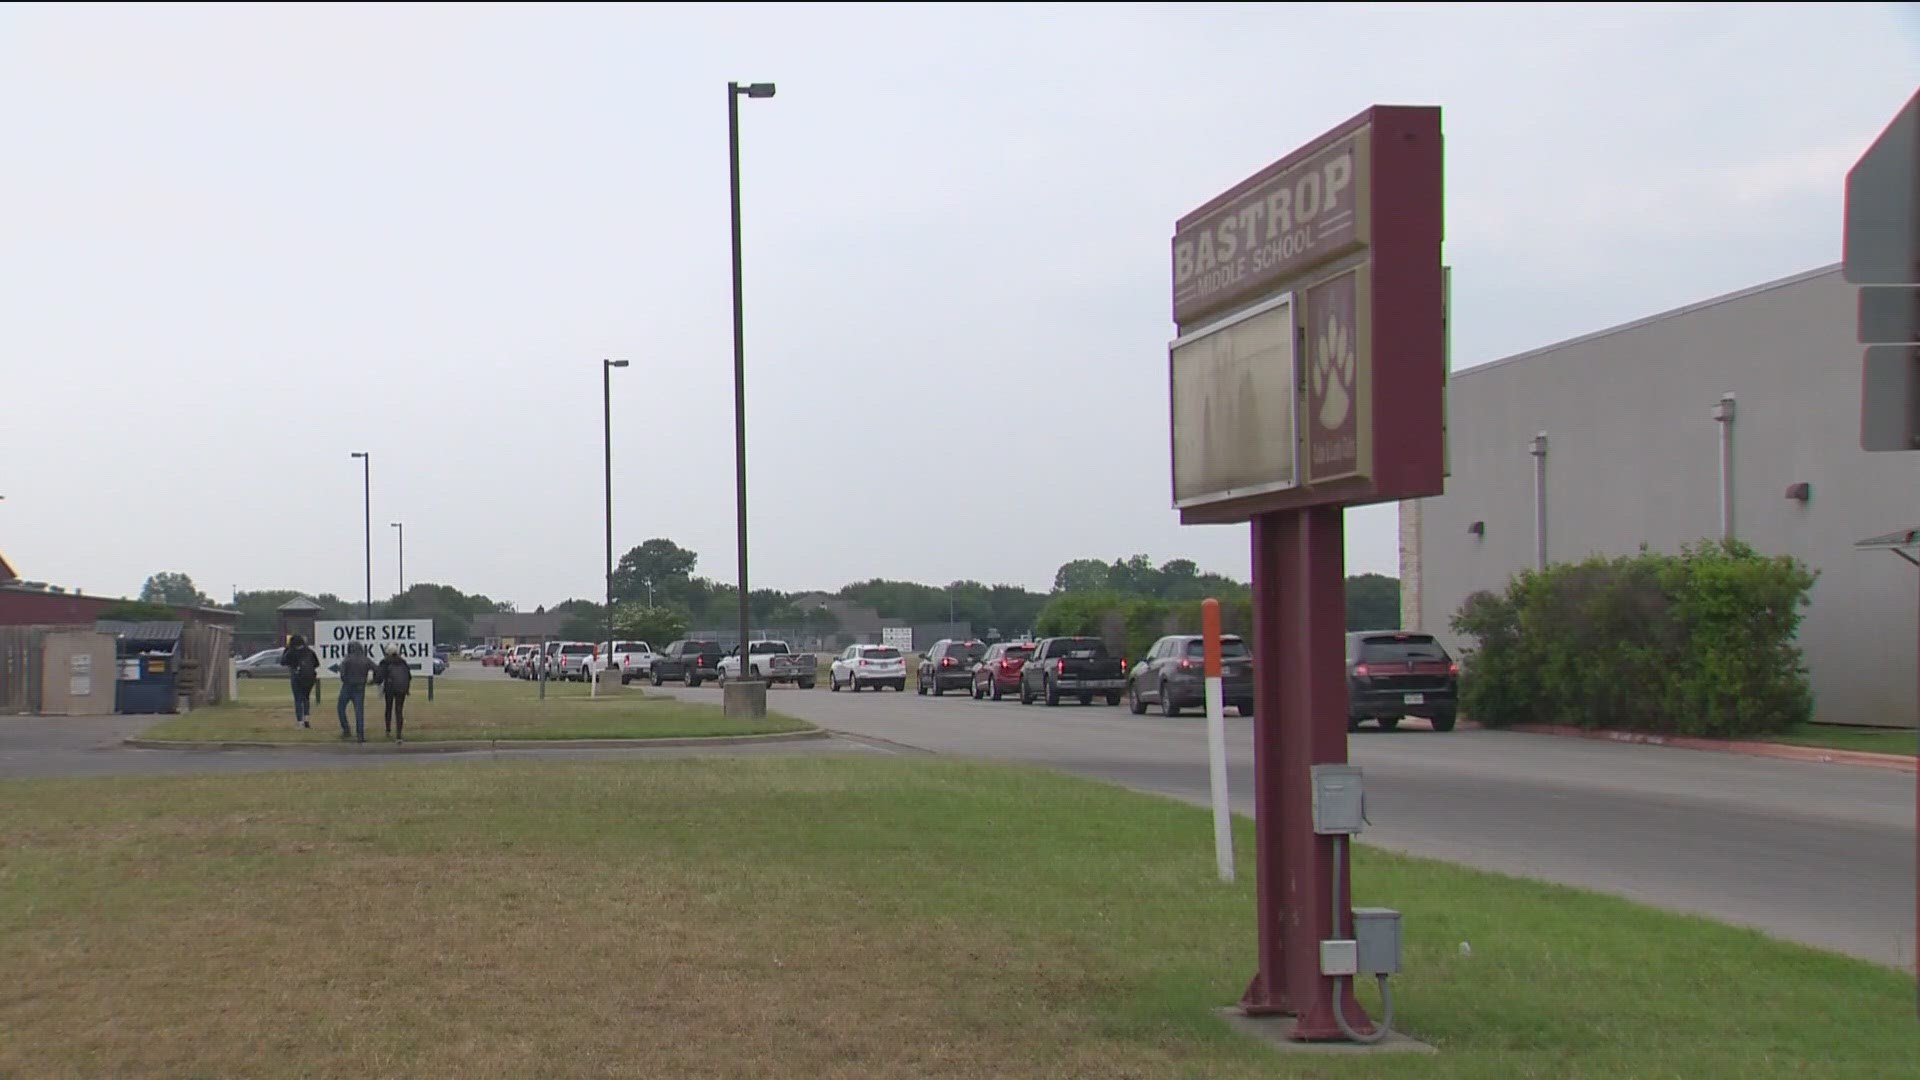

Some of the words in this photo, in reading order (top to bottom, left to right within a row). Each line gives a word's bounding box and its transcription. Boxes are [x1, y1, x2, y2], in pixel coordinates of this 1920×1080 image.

[1174, 155, 1353, 284] BASTROP
[1197, 257, 1245, 297] MIDDLE
[1253, 225, 1315, 273] SCHOOL
[320, 643, 375, 659] TRK
[333, 625, 376, 640] OVER
[382, 625, 416, 640] SIZE
